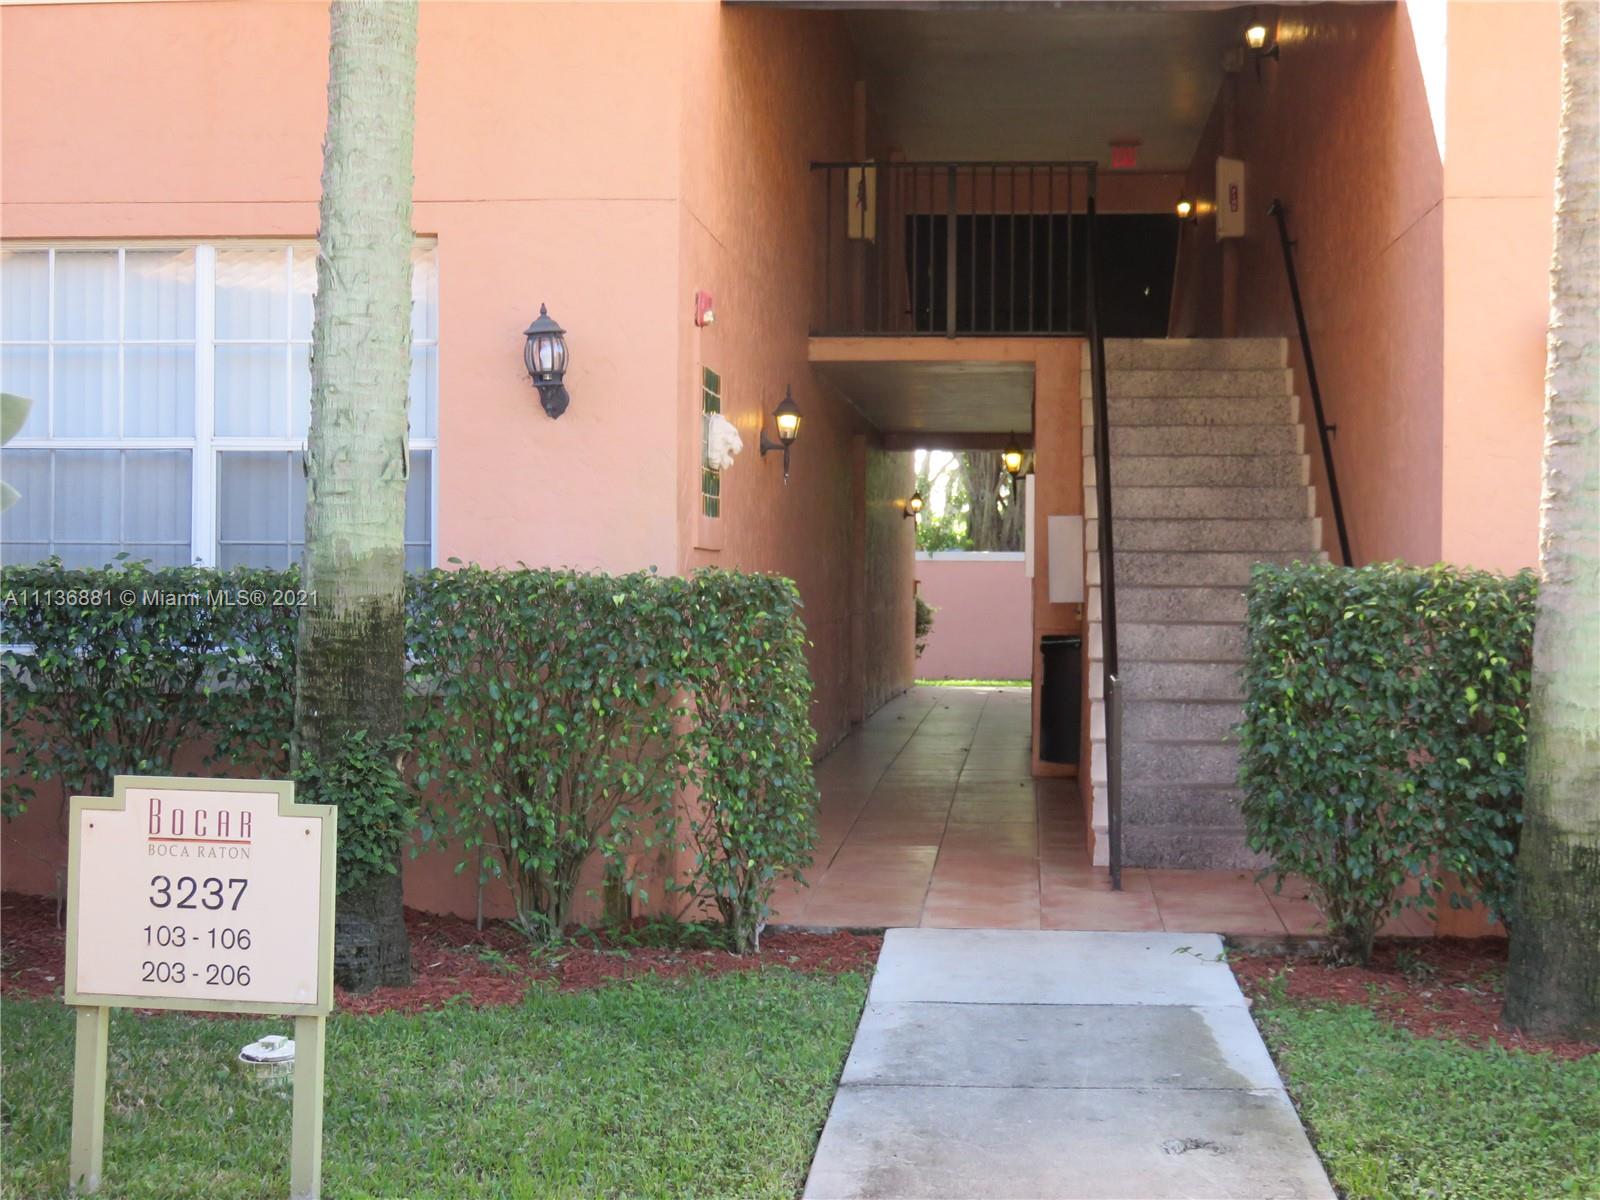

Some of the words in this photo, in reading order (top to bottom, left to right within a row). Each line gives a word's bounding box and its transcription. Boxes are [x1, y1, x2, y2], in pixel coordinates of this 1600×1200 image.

[149, 798, 252, 838] BOCAR
[148, 844, 190, 858] BOCA
[197, 846, 251, 859] RATON
[149, 875, 249, 911] 3237
[143, 925, 186, 947] 103
[207, 927, 252, 950] 106
[141, 961, 186, 983] 203
[206, 963, 251, 986] 206
